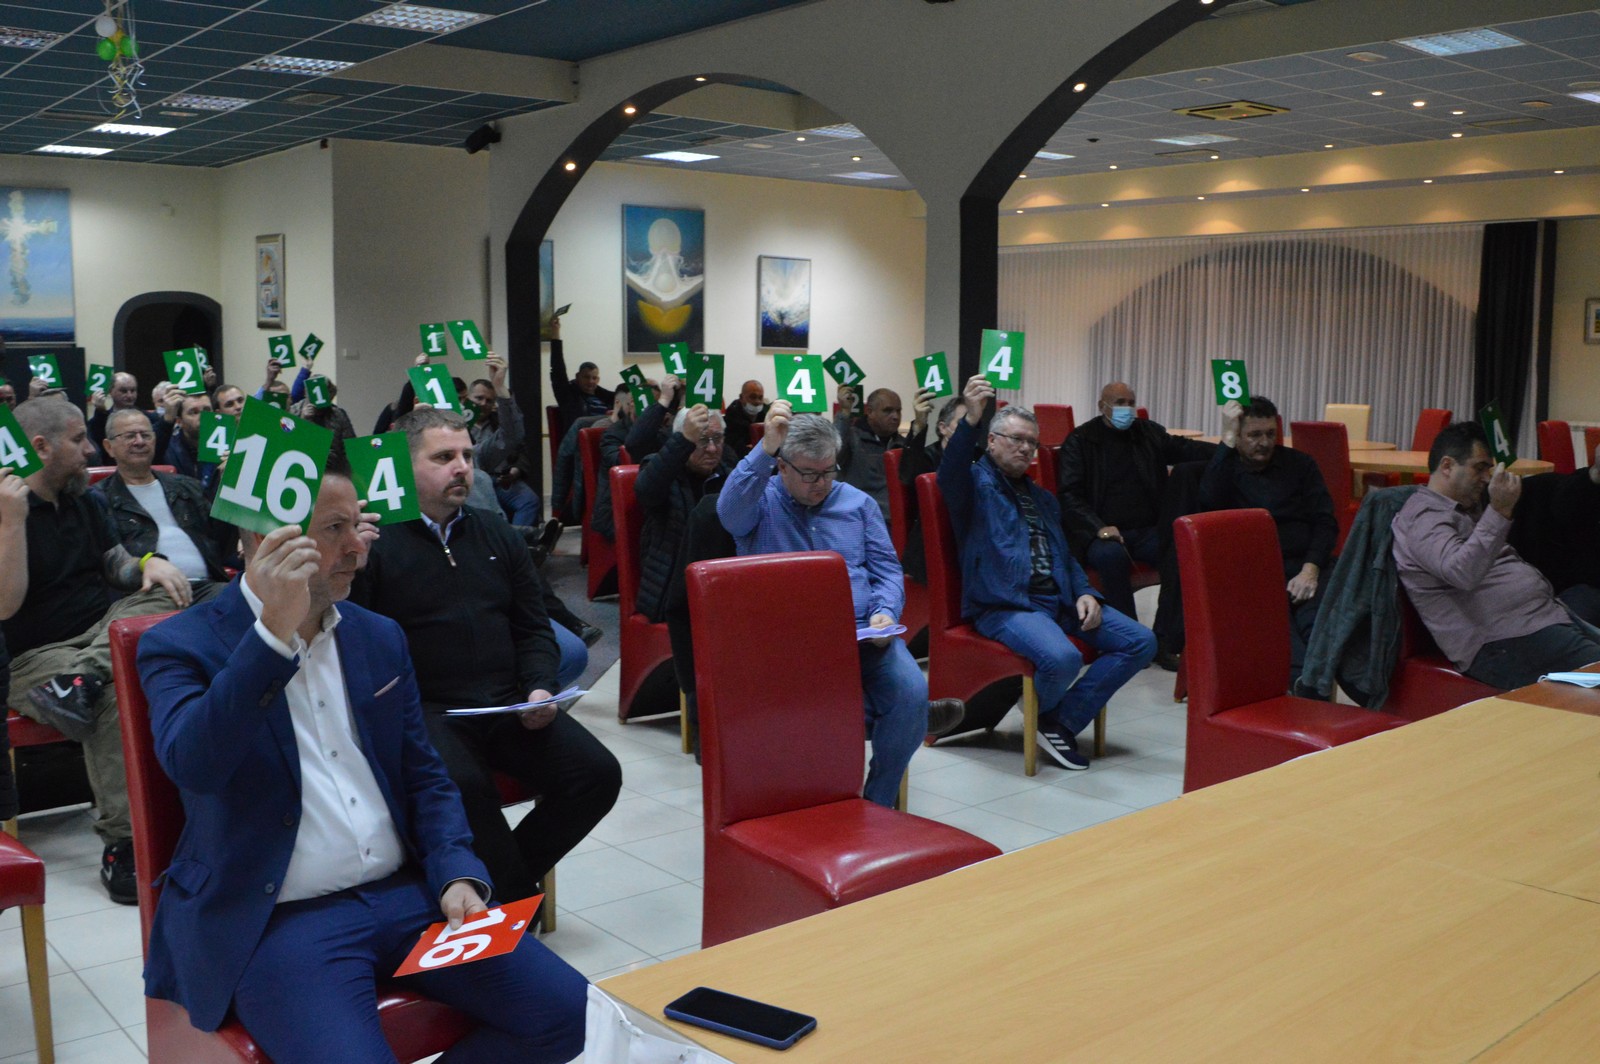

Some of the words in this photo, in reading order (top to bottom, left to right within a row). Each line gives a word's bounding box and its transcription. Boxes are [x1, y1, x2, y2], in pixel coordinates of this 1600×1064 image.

[274, 344, 290, 365] 2
[304, 342, 316, 358] 4
[427, 332, 443, 353] 1
[462, 330, 482, 354] 4
[38, 363, 56, 383] 2
[174, 361, 198, 390] 2
[669, 352, 687, 374] 1
[834, 361, 858, 385] 2
[987, 346, 1014, 382] 4
[90, 372, 106, 392] 2
[694, 368, 716, 403] 4
[787, 369, 816, 404] 4
[924, 365, 944, 392] 4
[1221, 371, 1243, 400] 8
[313, 386, 326, 404] 1
[426, 378, 453, 410] 1
[638, 393, 648, 412] 1
[0, 426, 29, 469] 4
[206, 426, 229, 456] 4
[1493, 418, 1510, 456] 4
[219, 433, 318, 524] 16
[368, 457, 405, 511] 4
[418, 908, 508, 968] 16
